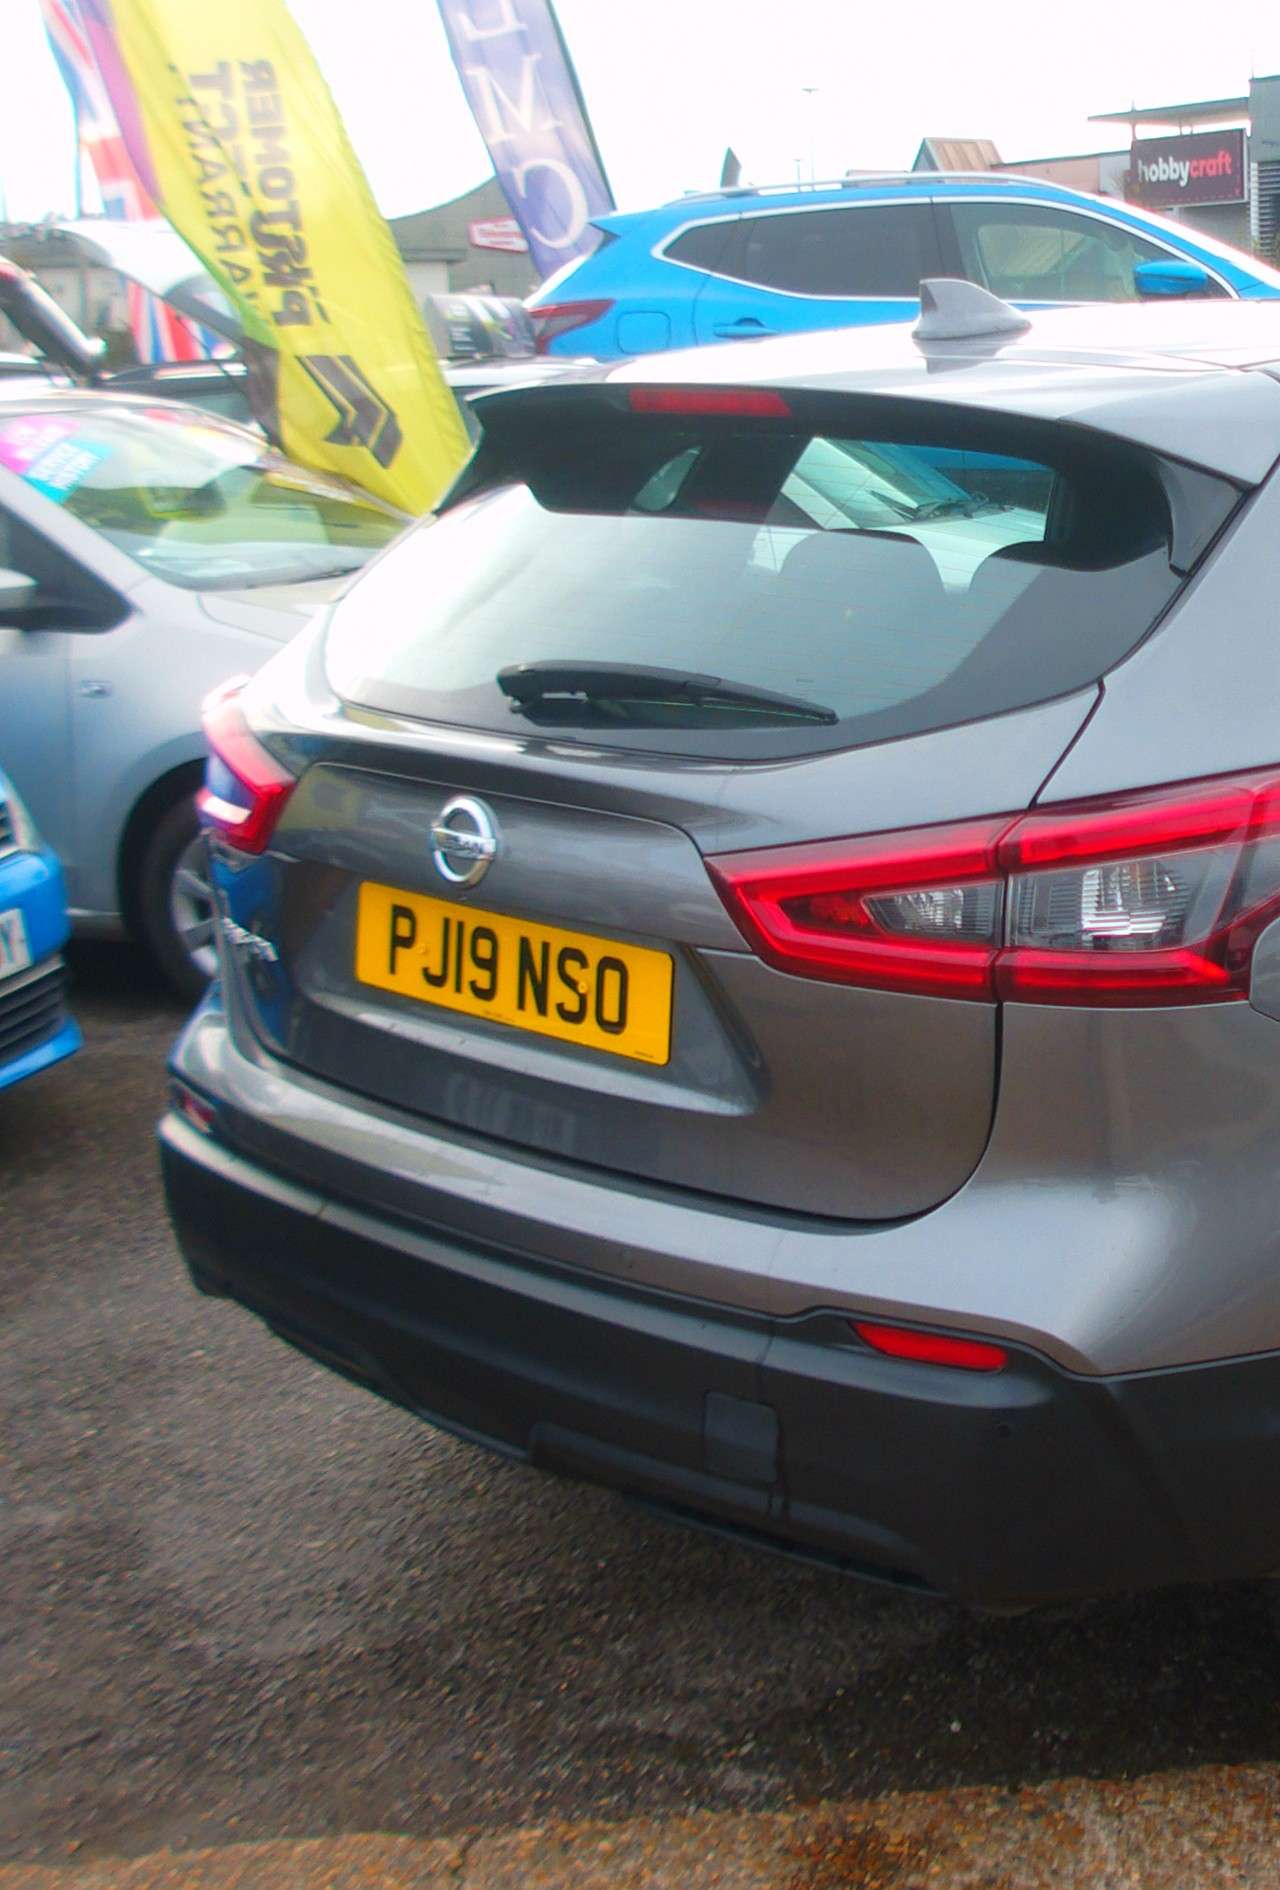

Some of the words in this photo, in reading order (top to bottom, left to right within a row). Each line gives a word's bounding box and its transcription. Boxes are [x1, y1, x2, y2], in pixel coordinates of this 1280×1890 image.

[1137, 150, 1232, 187] hobbycraft
[388, 903, 500, 1002] PJ19
[516, 936, 629, 1035] NSO
